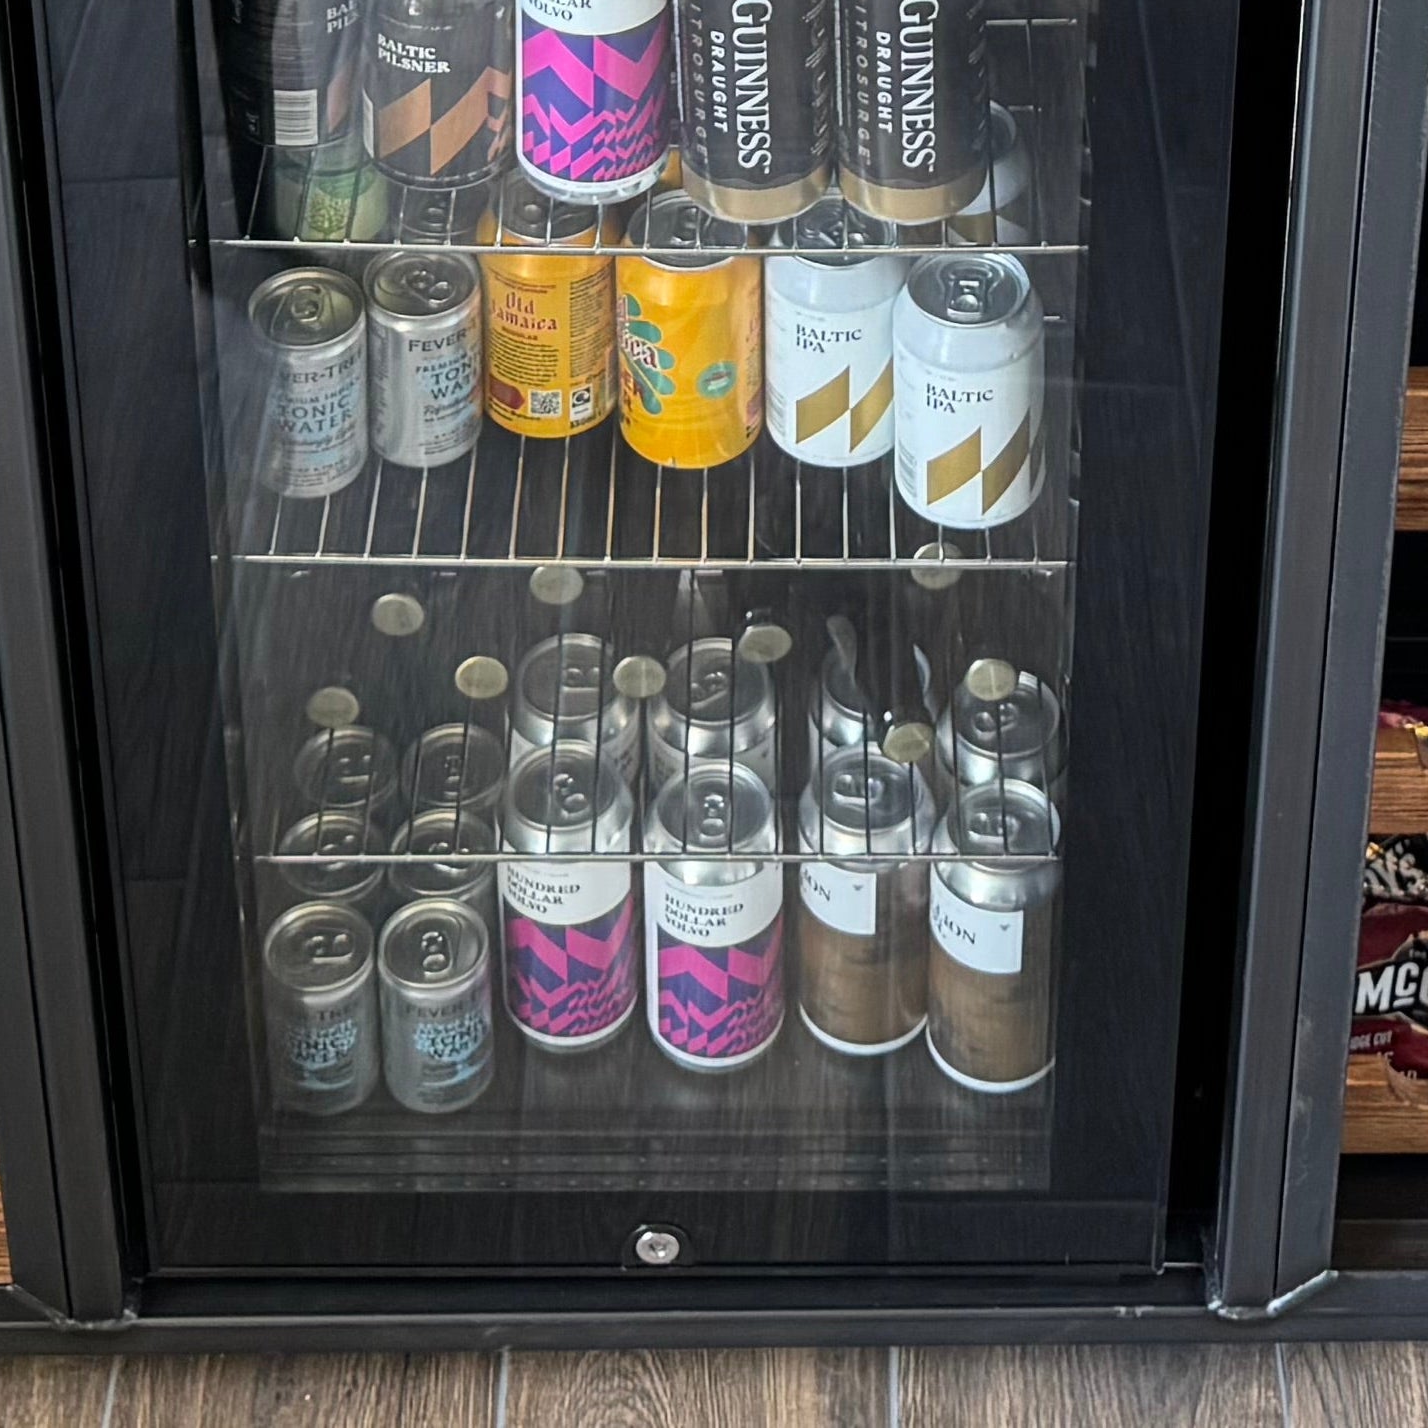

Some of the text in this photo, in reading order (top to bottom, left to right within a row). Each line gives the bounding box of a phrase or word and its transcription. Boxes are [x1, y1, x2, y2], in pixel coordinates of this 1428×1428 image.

[376, 33, 437, 61] BALTIC
[376, 46, 452, 75] PILSNER
[709, 30, 729, 133] DRAUGHT
[875, 30, 893, 134] DRAUGHT
[505, 292, 536, 316] Old
[795, 322, 863, 344] BALTIC
[795, 335, 826, 354] IPA
[925, 382, 995, 404] BALTIC
[925, 394, 957, 415] IPA
[276, 398, 351, 421] TONIC
[277, 412, 353, 434] WATER
[507, 863, 581, 894] HUNDRED
[507, 875, 564, 906] DOLLAR
[664, 892, 745, 917] HUNDRED
[664, 903, 728, 928] DOLLAR
[664, 913, 711, 938] VOLVO
